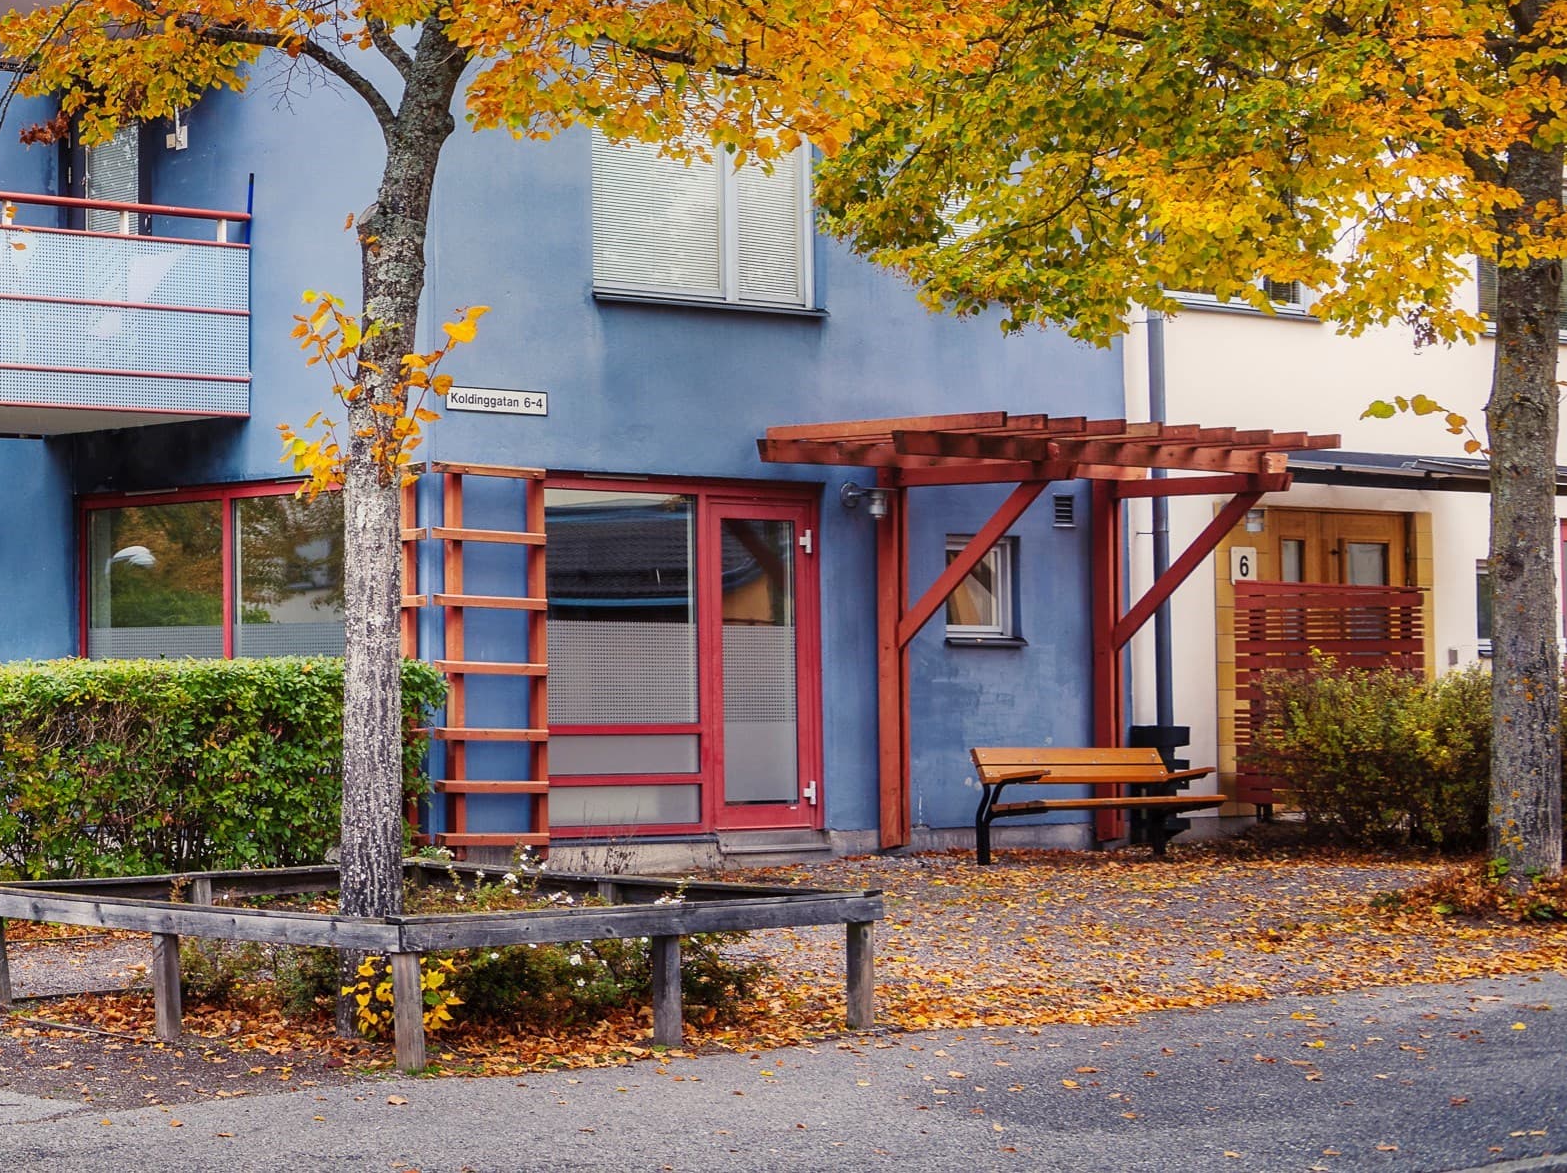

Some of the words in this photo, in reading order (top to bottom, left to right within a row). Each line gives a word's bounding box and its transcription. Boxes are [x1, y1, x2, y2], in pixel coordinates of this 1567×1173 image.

[450, 392, 519, 408] Koldinggatan
[523, 397, 543, 409] 6-4
[1239, 555, 1249, 577] 6
